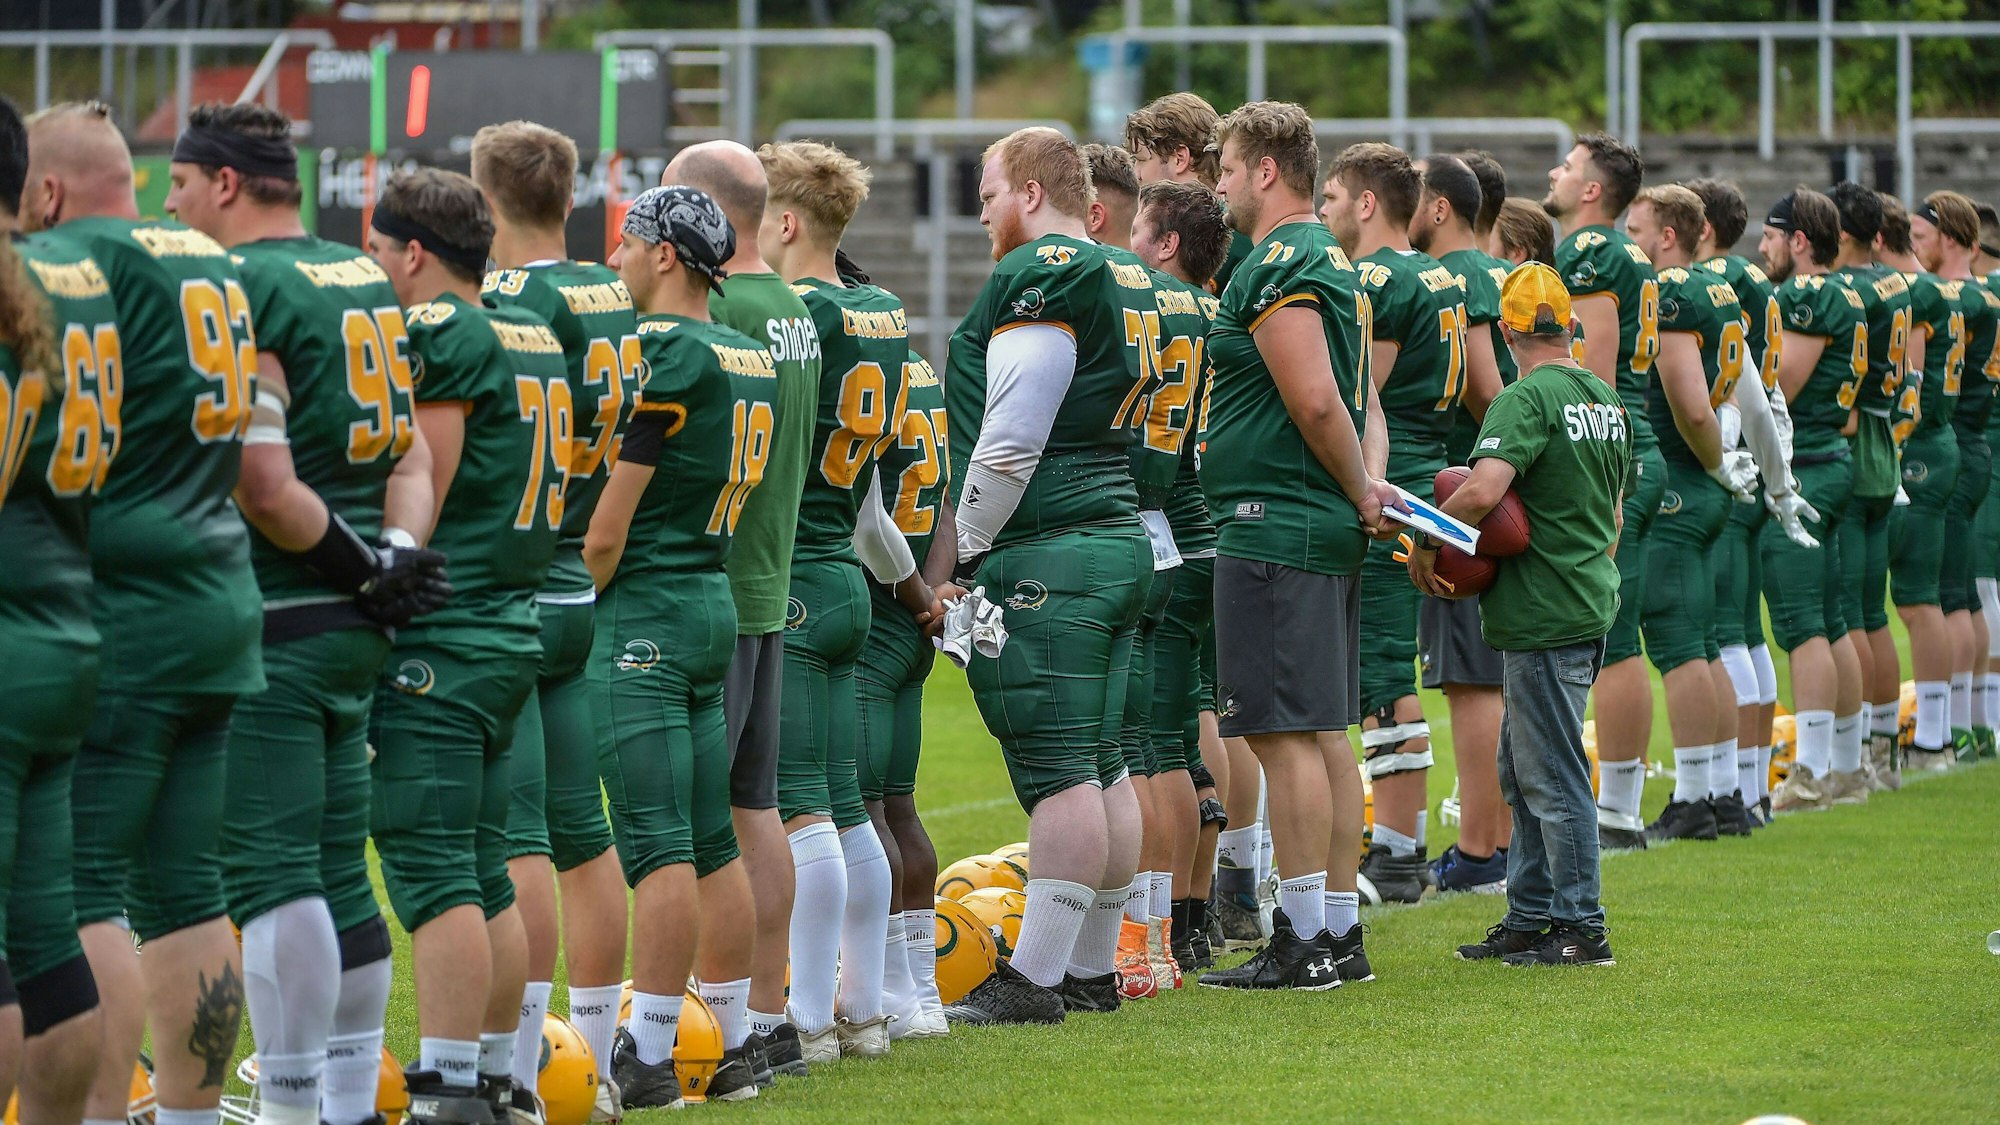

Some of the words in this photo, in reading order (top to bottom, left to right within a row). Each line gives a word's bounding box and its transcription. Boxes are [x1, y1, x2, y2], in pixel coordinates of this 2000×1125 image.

[1357, 262, 1392, 287] 76
[46, 321, 124, 499] 69
[341, 306, 416, 464] 95
[513, 374, 573, 532] 79
[704, 398, 775, 538] 18
[411, 1101, 441, 1117] NIKE
[687, 1076, 700, 1090] 18
